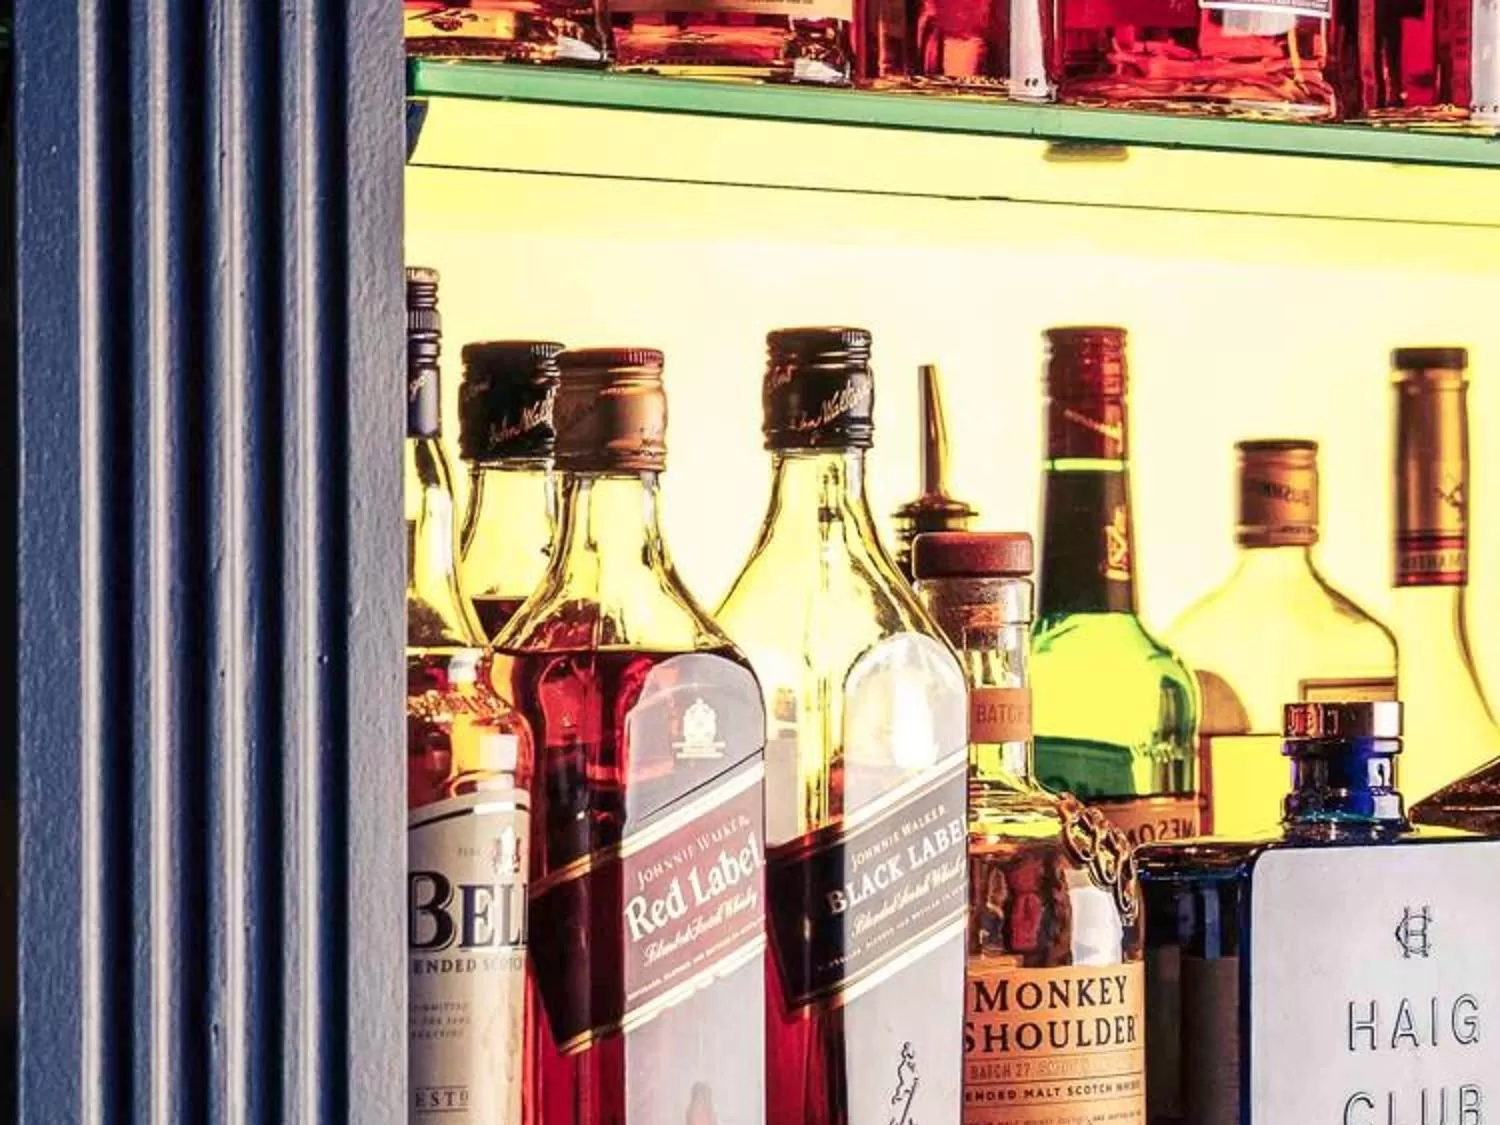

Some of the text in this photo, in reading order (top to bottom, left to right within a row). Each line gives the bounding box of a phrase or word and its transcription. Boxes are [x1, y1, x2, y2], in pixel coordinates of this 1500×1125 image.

[624, 830, 763, 943] Red Label
[825, 853, 905, 914] BLACK
[973, 974, 1128, 1013] MONKEY
[964, 1015, 1137, 1054] SHOULDER
[1347, 993, 1481, 1052] HAIG
[1023, 1086, 1061, 1100] MALT
[1067, 1082, 1113, 1098] SCOTCH
